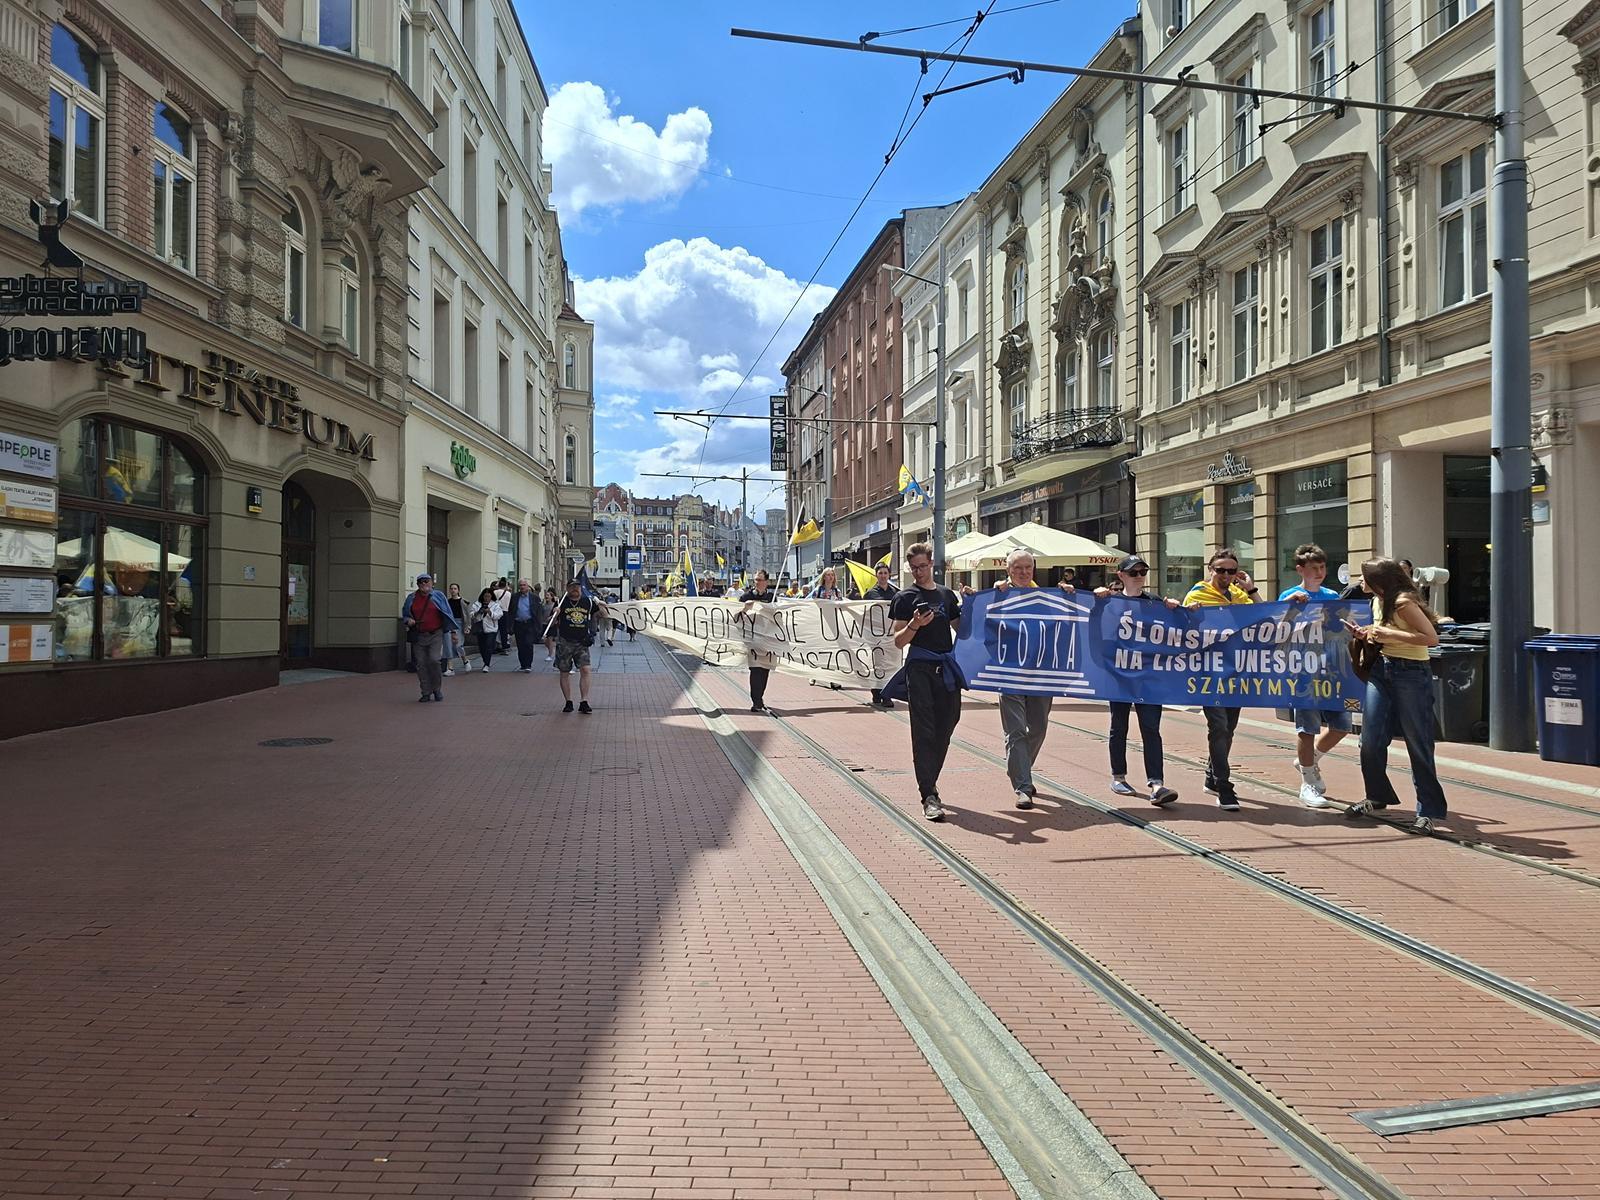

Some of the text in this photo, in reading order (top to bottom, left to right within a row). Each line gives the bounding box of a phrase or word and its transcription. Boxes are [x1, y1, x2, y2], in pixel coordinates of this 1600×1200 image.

[27, 292, 137, 311] machina
[1298, 477, 1333, 491] VERSACE
[998, 620, 1075, 670] GODKA
[1114, 648, 1143, 670] NA
[1234, 650, 1327, 674] UNESCO!
[1186, 676, 1342, 698] SZAFNYMY TO!
